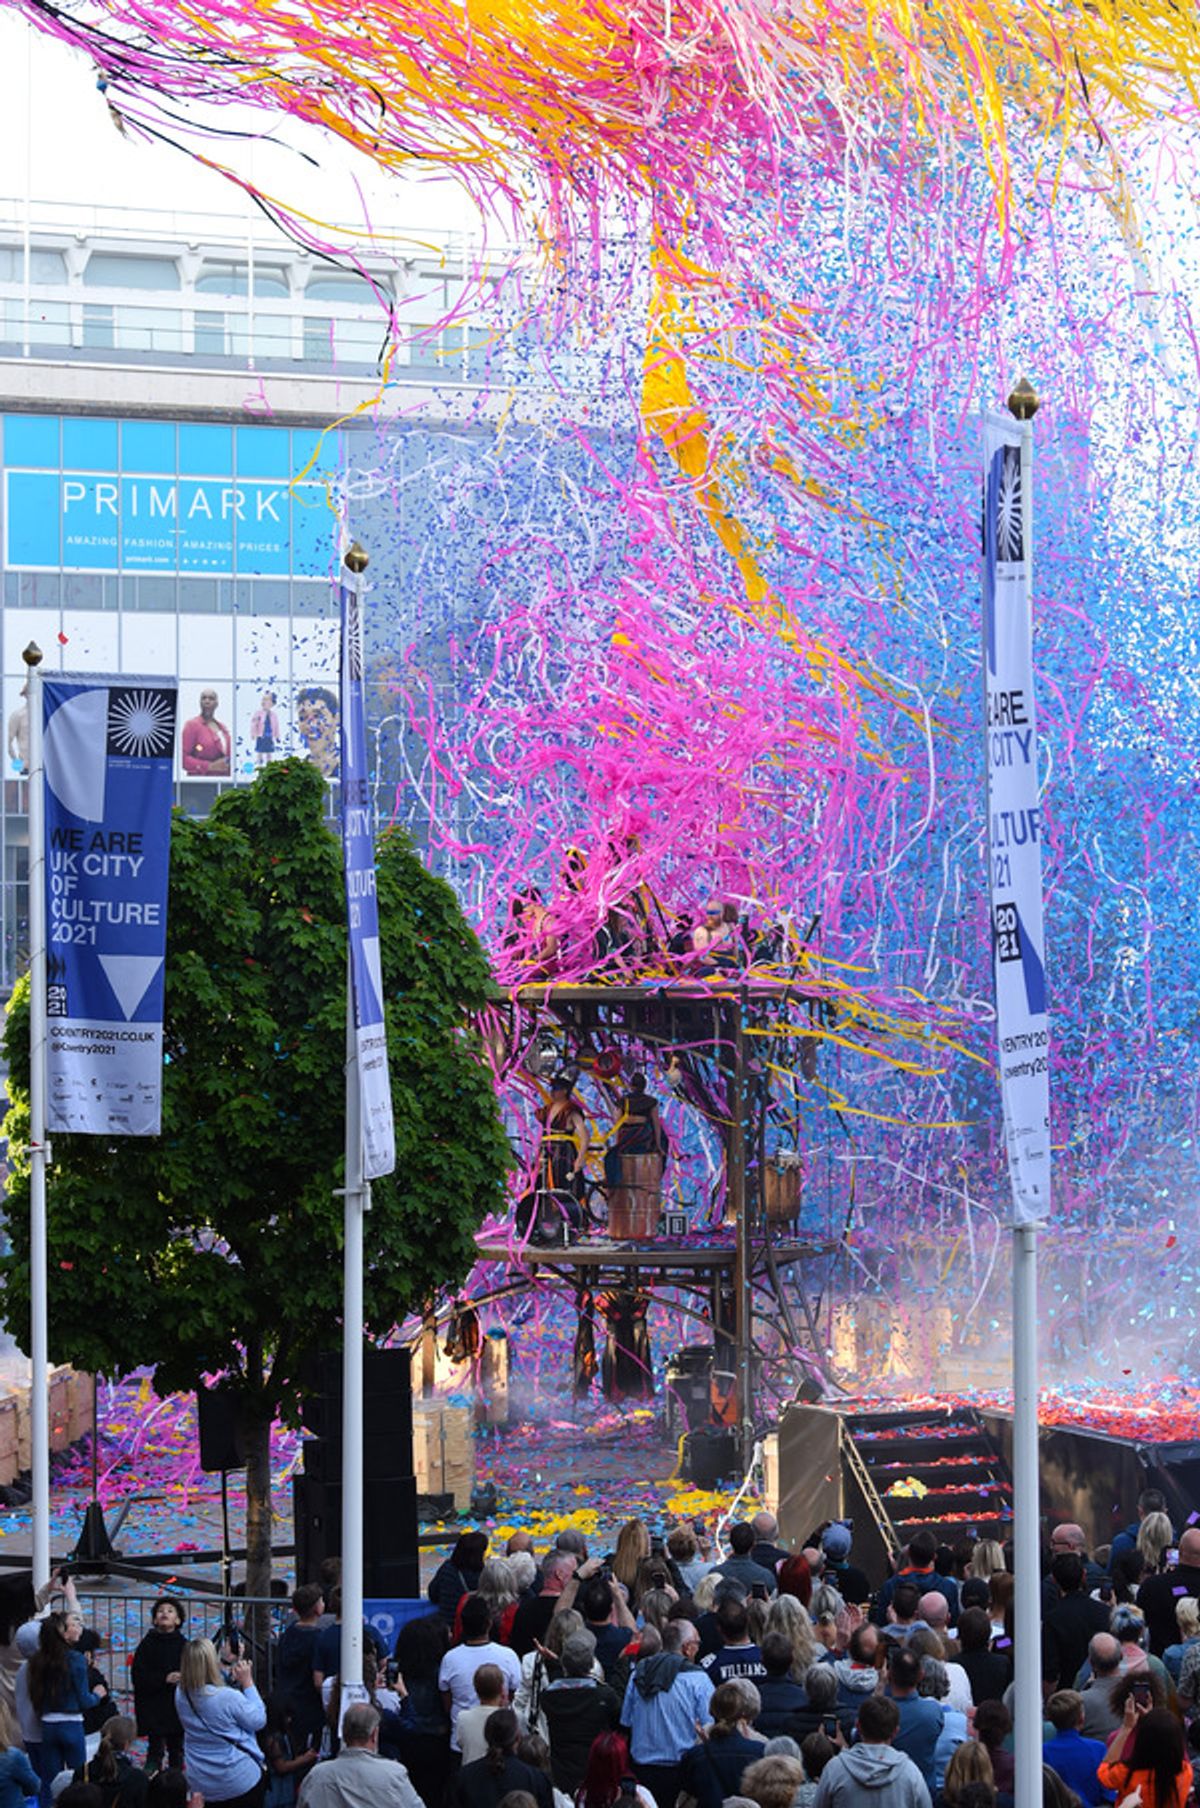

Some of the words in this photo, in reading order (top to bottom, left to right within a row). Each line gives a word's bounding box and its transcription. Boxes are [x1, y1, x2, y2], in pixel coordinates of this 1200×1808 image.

[63, 481, 280, 522] PRIMARK
[66, 535, 118, 546] AMAZING
[183, 541, 232, 551] AMAZING
[239, 543, 281, 553] PRICES
[50, 828, 85, 852] WE
[91, 832, 143, 854] ARE
[50, 850, 78, 874] UK
[82, 854, 144, 877] CITY
[51, 874, 79, 897] OF
[51, 898, 160, 926] CULTURE
[997, 905, 1016, 932] 20
[51, 921, 97, 945] 2021
[999, 933, 1020, 958] 21
[720, 1663, 768, 1679] WILLIAMS
